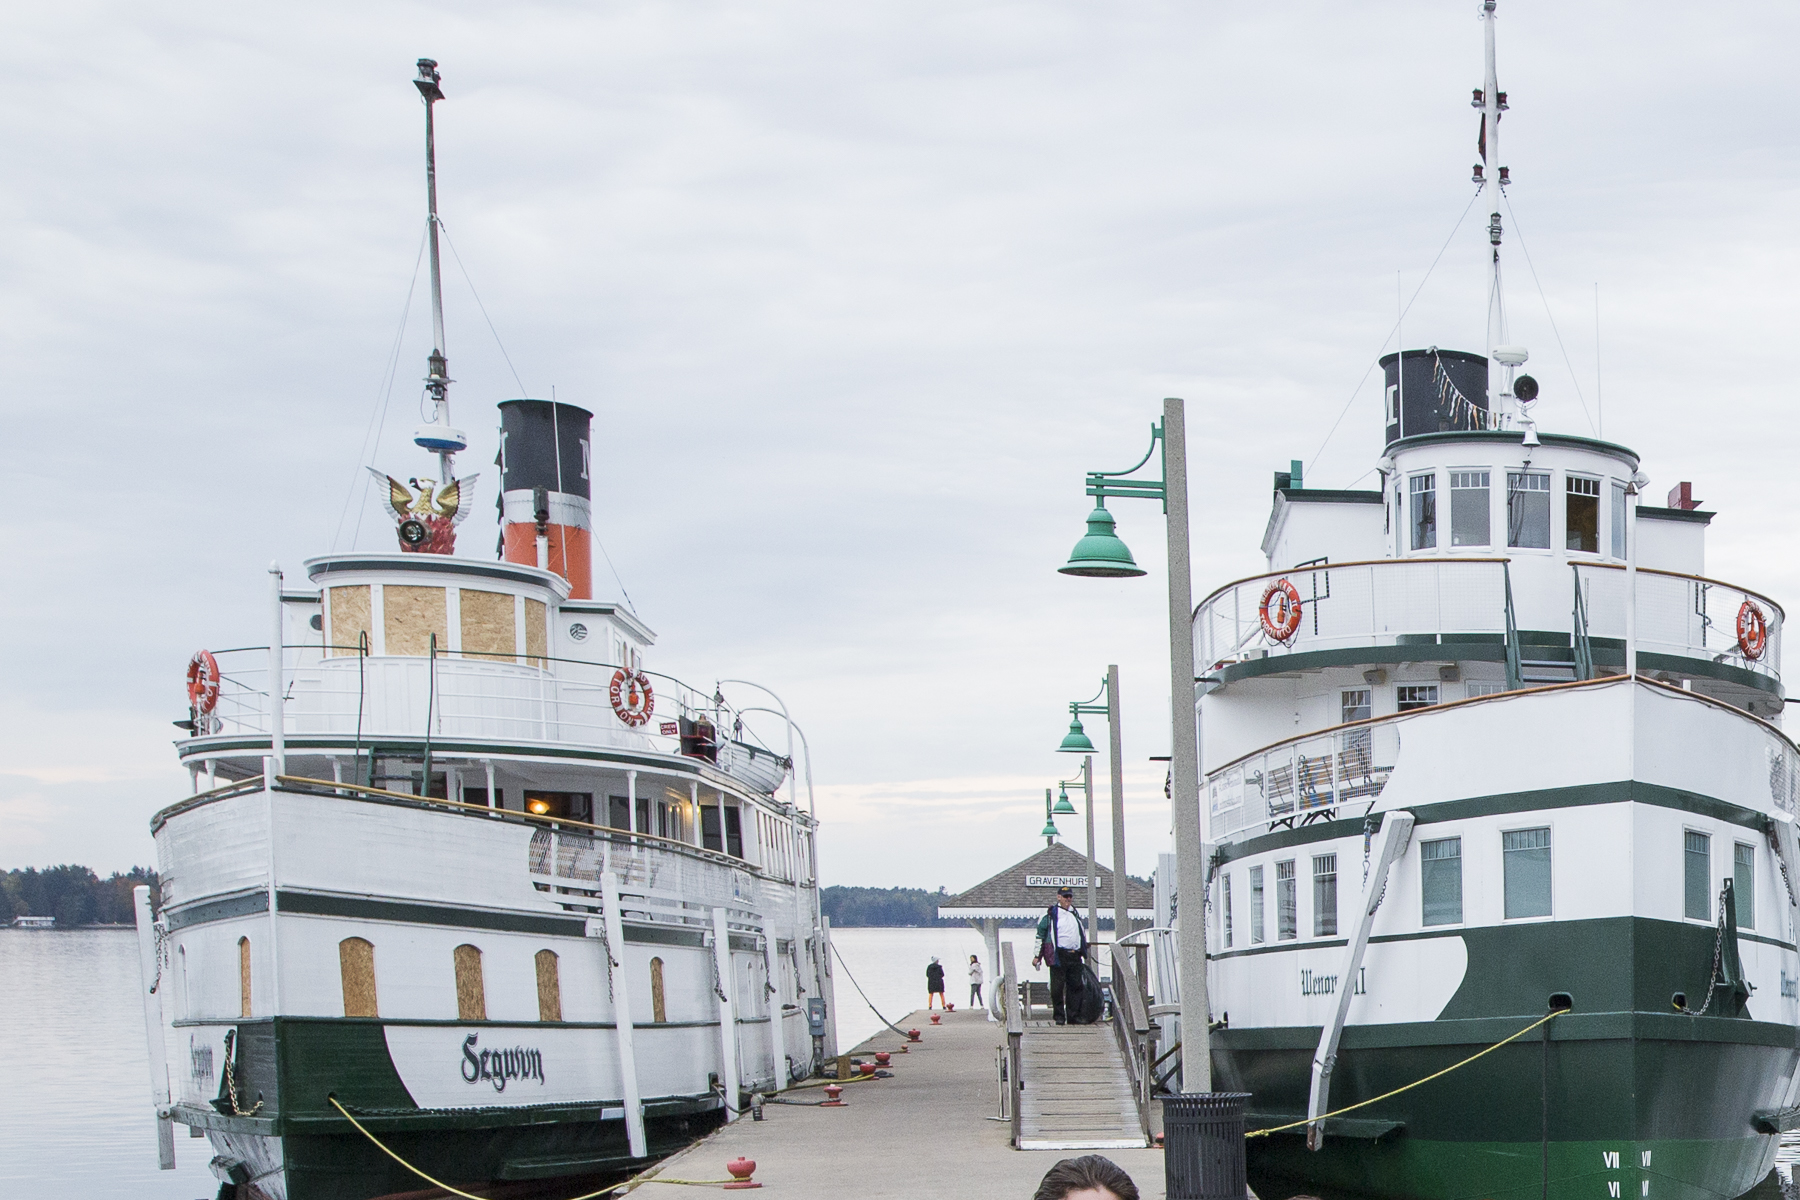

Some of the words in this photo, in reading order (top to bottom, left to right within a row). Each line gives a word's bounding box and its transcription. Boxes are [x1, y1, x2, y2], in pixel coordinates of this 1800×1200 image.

[1029, 876, 1096, 886] GRAVENHURS
[461, 1032, 545, 1093] Segwun
[1603, 1151, 1620, 1169] VII
[1608, 1181, 1620, 1198] VI
